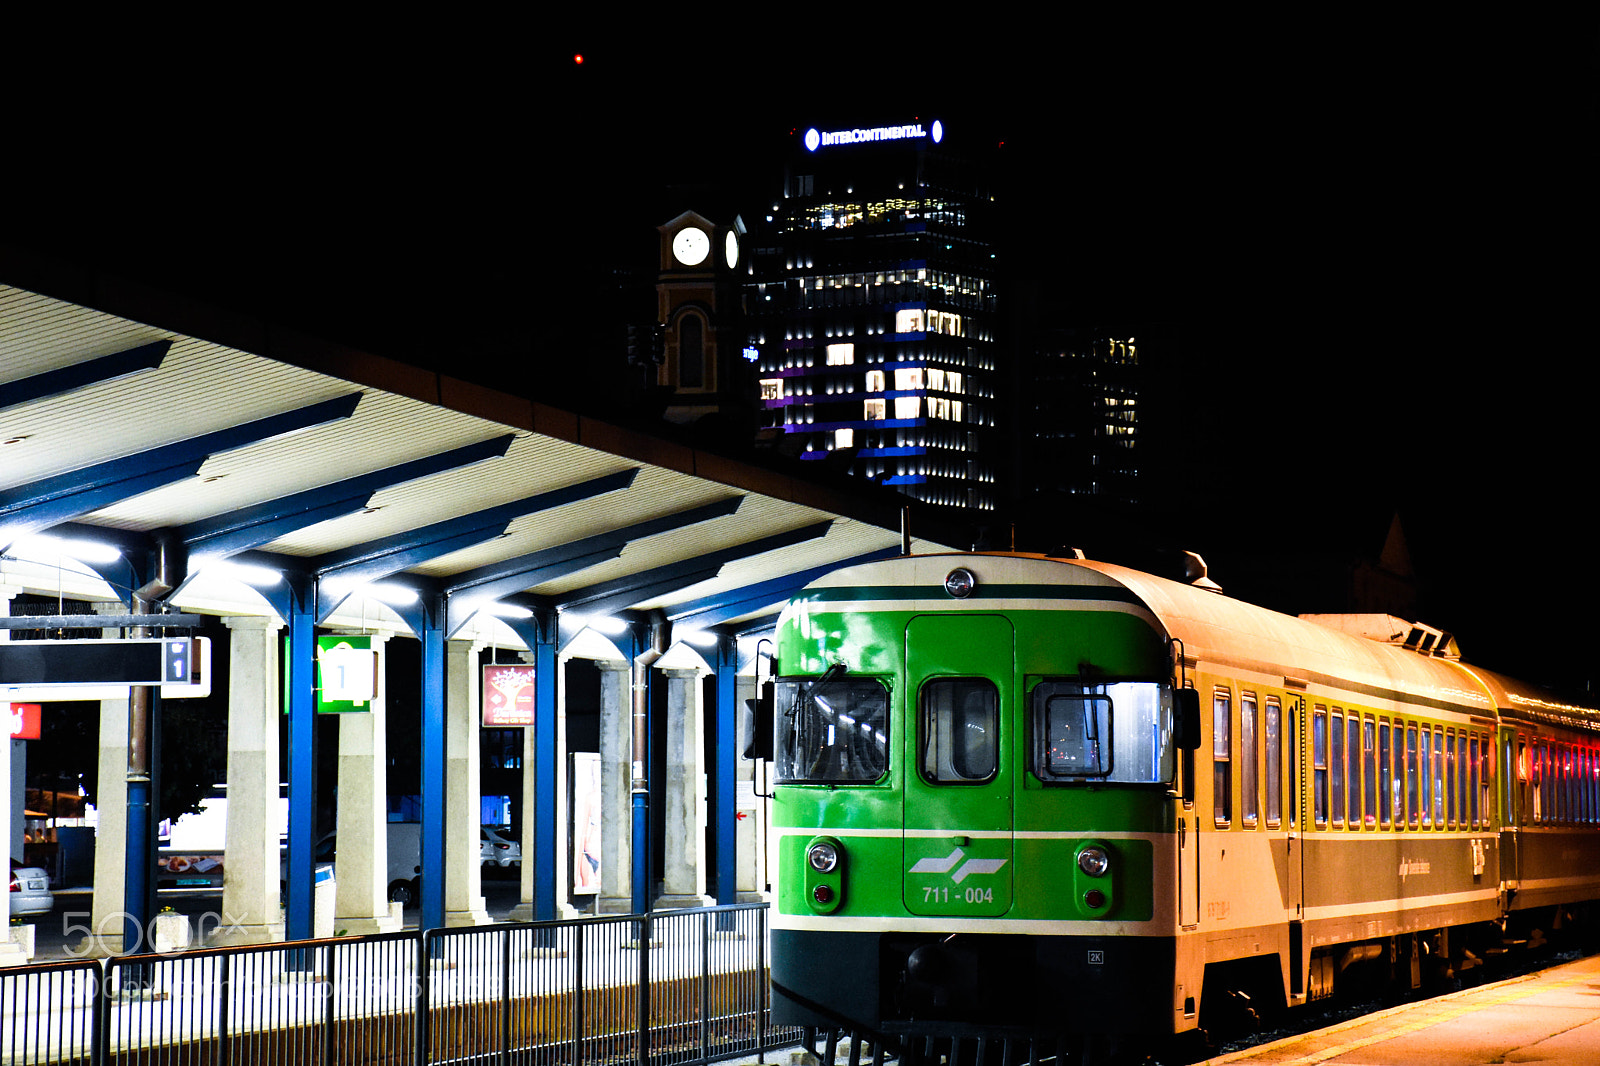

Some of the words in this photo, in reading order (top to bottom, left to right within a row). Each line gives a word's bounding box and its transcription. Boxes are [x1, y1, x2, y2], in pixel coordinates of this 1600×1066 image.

[173, 659, 182, 678] 1
[337, 665, 345, 689] 1
[922, 887, 948, 903] 711
[965, 887, 994, 904] 004
[1090, 953, 1101, 962] 2K
